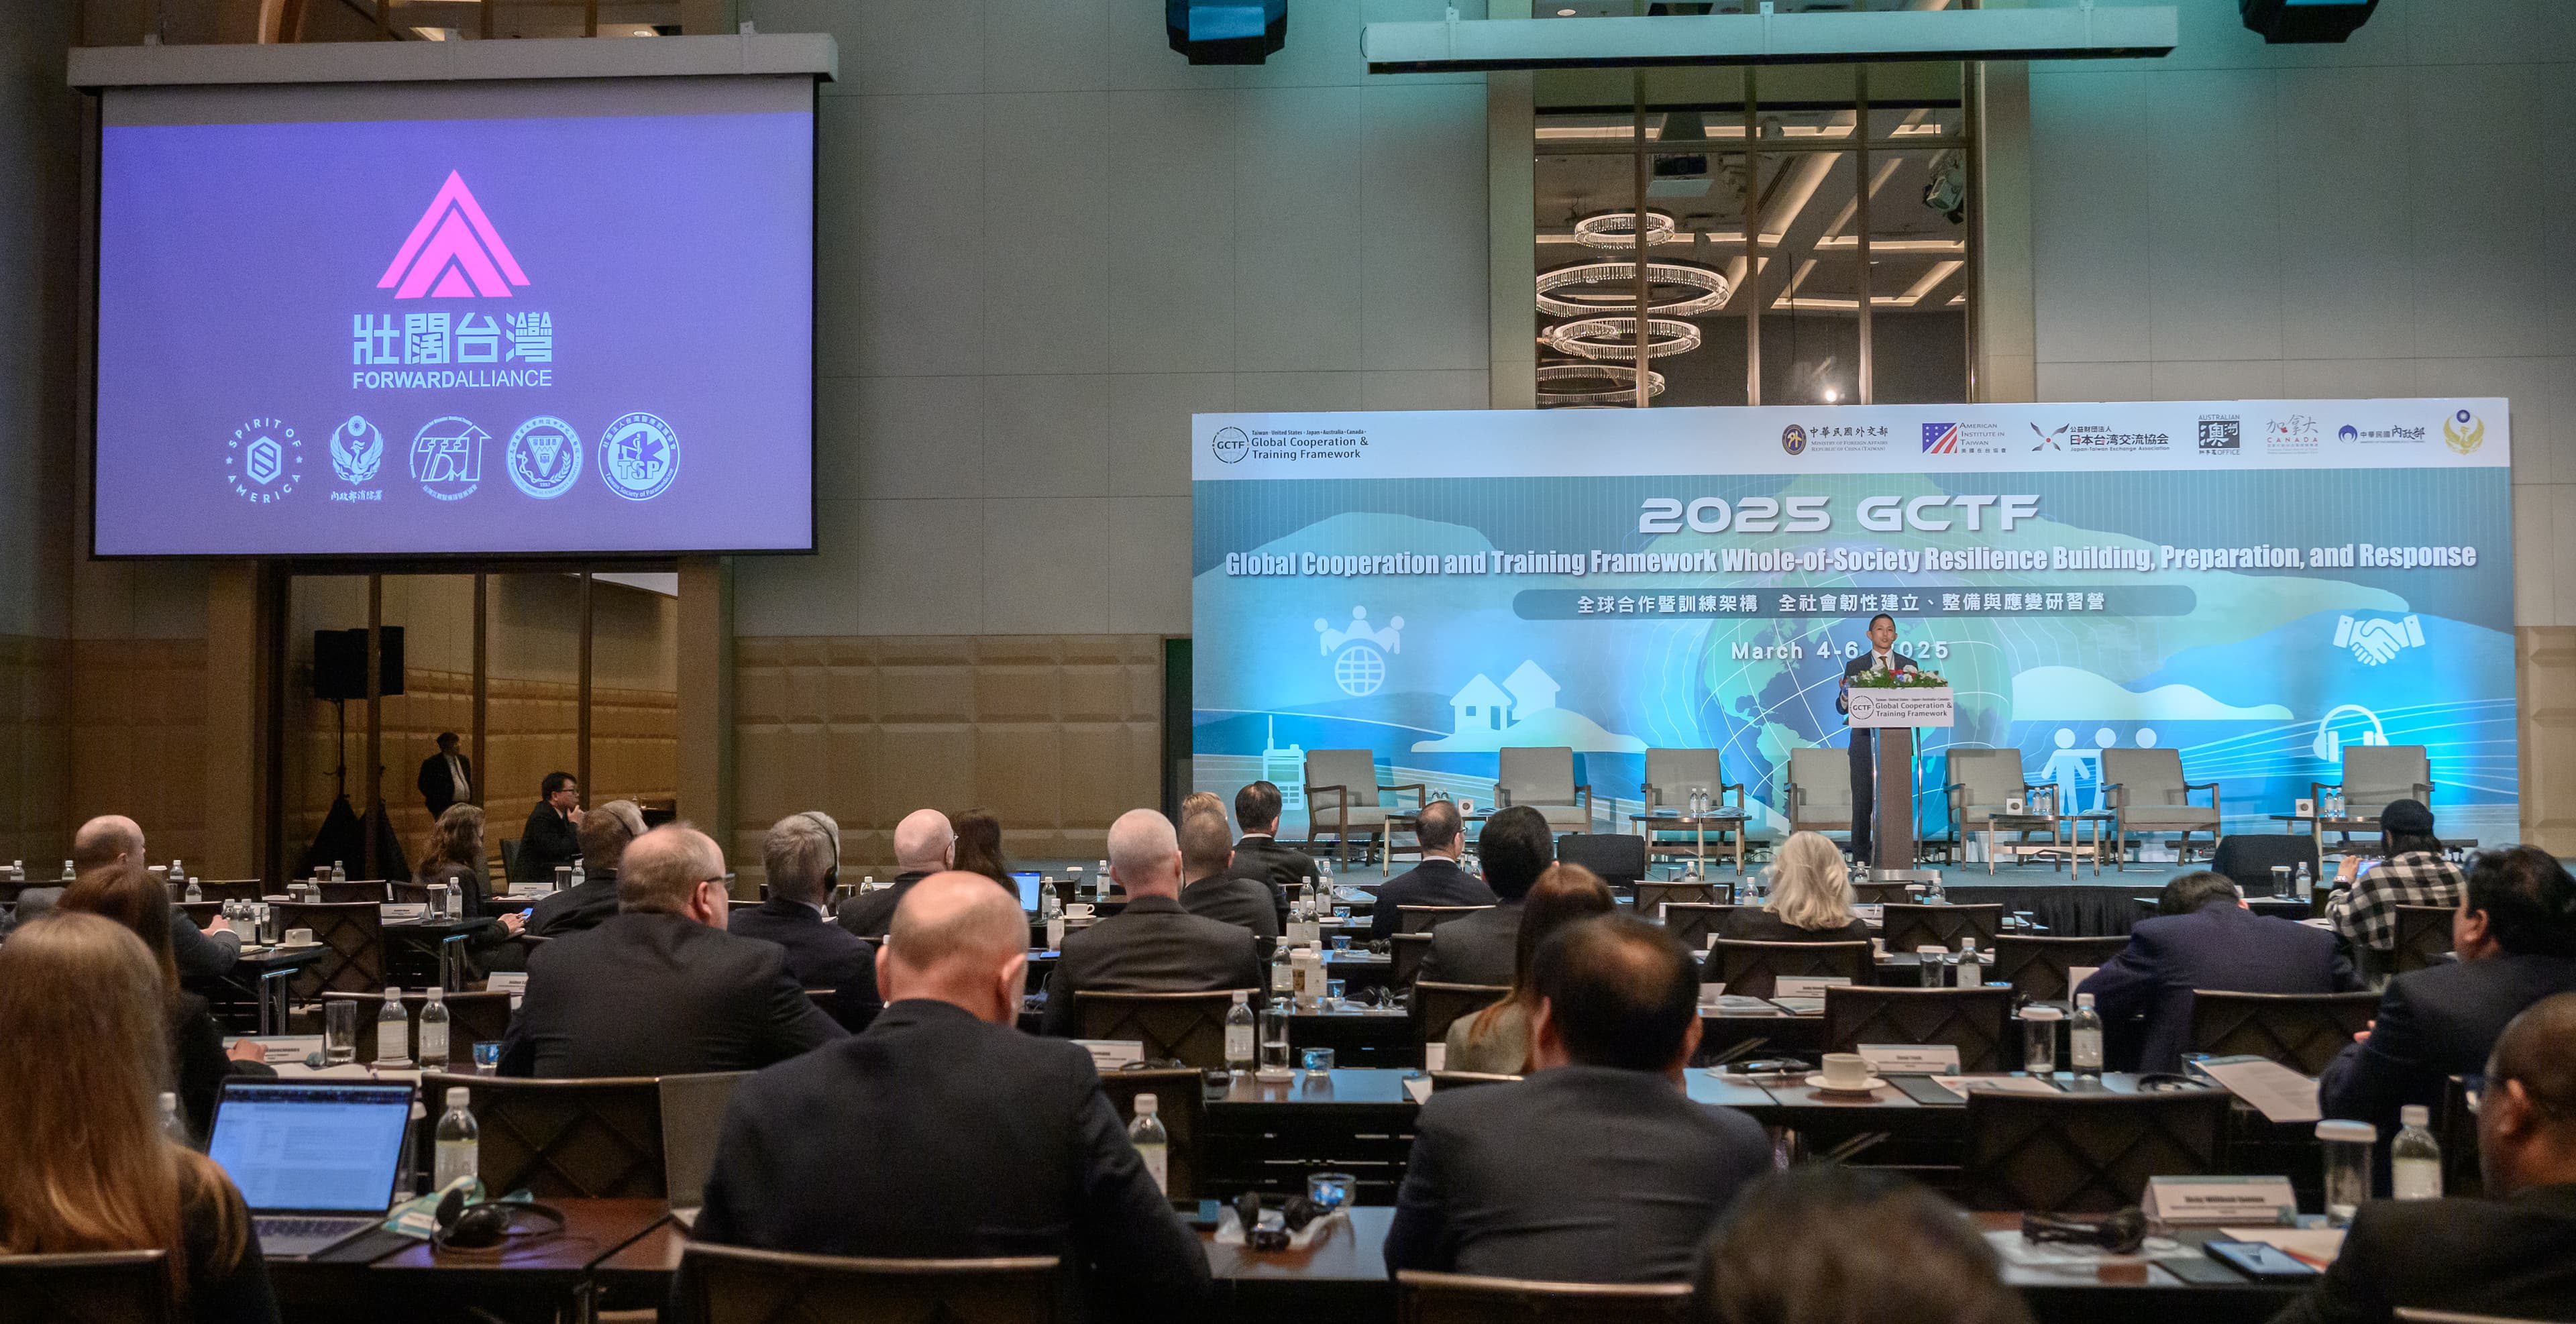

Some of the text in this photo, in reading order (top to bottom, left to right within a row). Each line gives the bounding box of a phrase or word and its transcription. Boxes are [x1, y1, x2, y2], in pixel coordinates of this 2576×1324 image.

[353, 311, 553, 365] 壯闊台灣
[352, 370, 552, 390] FORWARDALLIANCE
[229, 417, 302, 449] SPIRIT OF
[1809, 425, 1888, 439] 中華民國外交部
[2265, 414, 2318, 436] 加拿大
[1217, 441, 1245, 449] GCTF
[1251, 436, 1368, 449] Global Cooperation &
[2070, 433, 2169, 445] 日本台湾交流協会
[1252, 449, 1361, 461] Training Framework
[617, 460, 661, 480] TSP
[227, 474, 301, 504] AMERICA
[1638, 494, 2041, 534] 2025 GCTF
[1225, 543, 2477, 577] Global Cooperation and Training Framework Whole-of-Society Resilience Building, Preparation, and Response
[1577, 594, 1758, 614] 全球合作暨訓練架構
[1731, 642, 1804, 659] March
[1893, 640, 1949, 659] 025
[1876, 710, 1906, 718] Training
[1900, 702, 1944, 710] Cooperation
